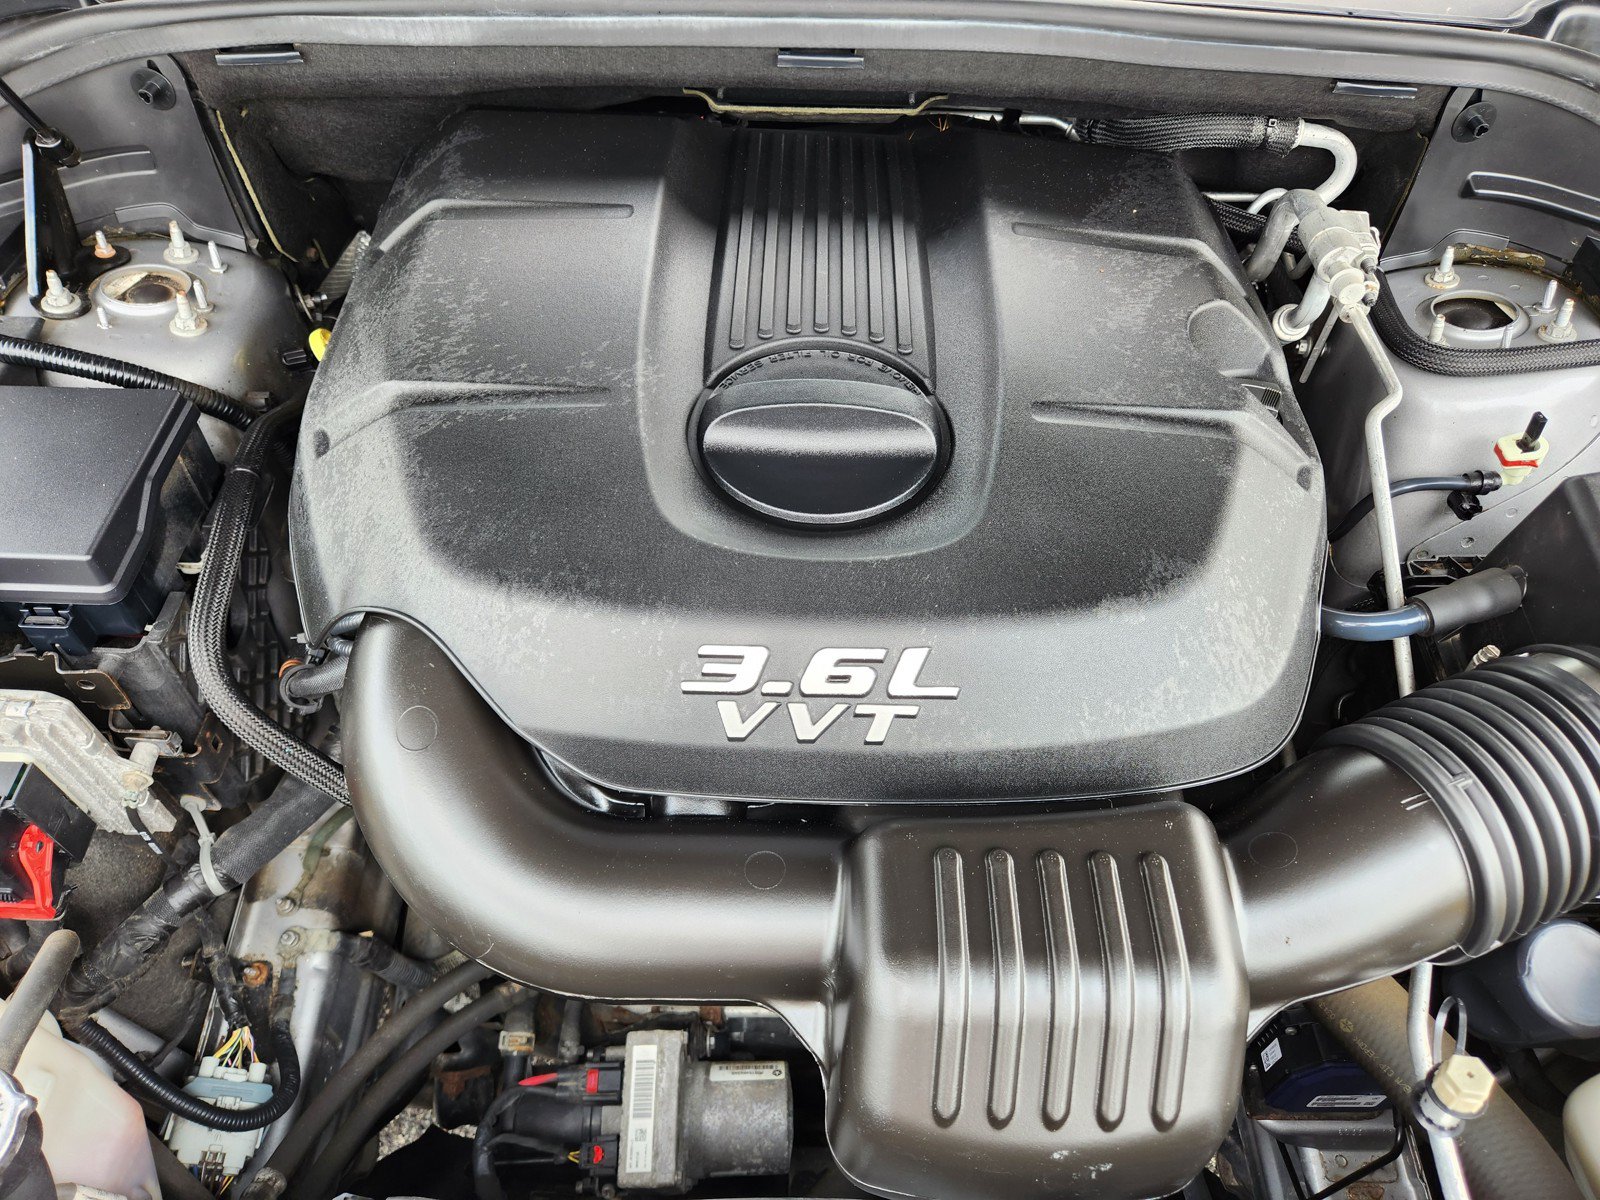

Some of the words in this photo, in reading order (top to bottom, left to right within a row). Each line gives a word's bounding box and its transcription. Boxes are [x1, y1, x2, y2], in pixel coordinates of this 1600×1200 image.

[768, 351, 812, 364] FILTER
[818, 350, 841, 359] OIL
[847, 353, 875, 367] FOR
[719, 360, 764, 390] SERVICE
[877, 364, 922, 397] REMOVE
[680, 644, 961, 700] 3.6L
[716, 700, 921, 745] VVT
